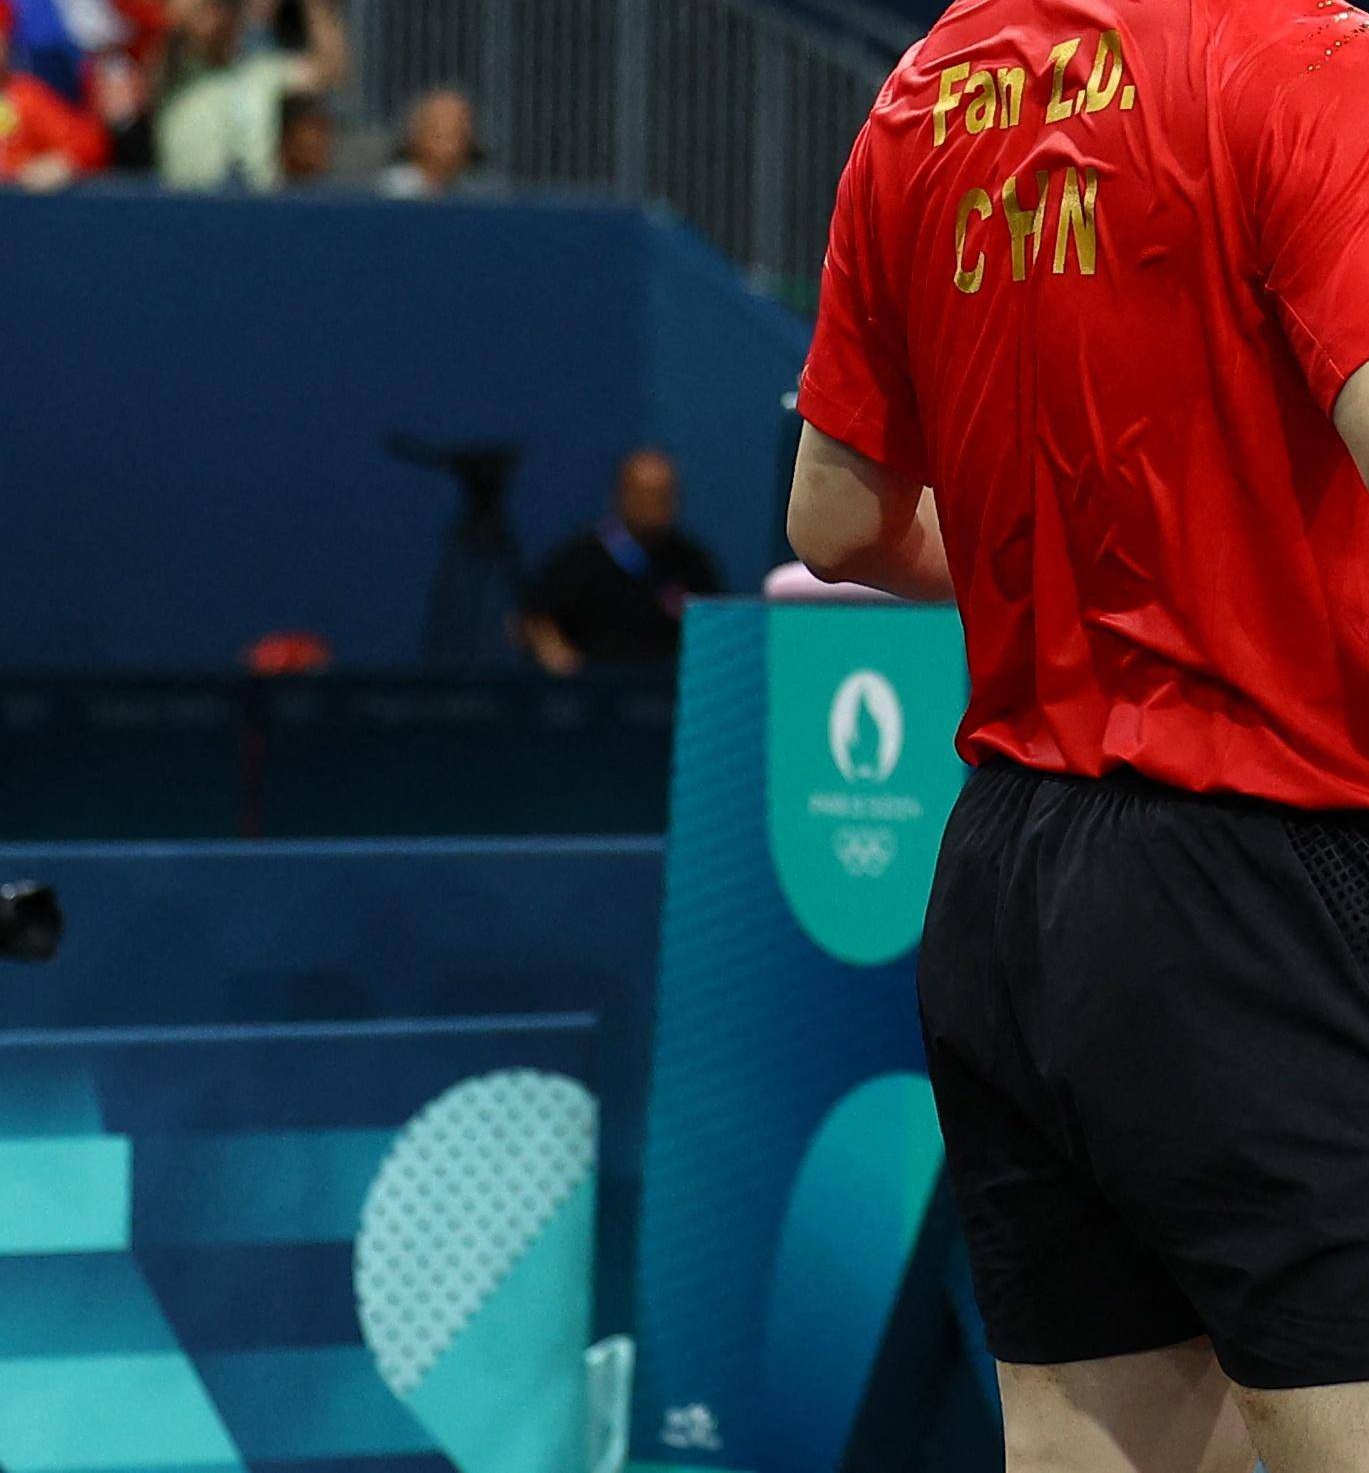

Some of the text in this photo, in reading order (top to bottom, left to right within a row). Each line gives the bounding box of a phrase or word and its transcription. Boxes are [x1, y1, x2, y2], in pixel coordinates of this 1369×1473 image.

[932, 29, 1136, 147] Fan Z.D.
[953, 166, 1098, 294] CHN
